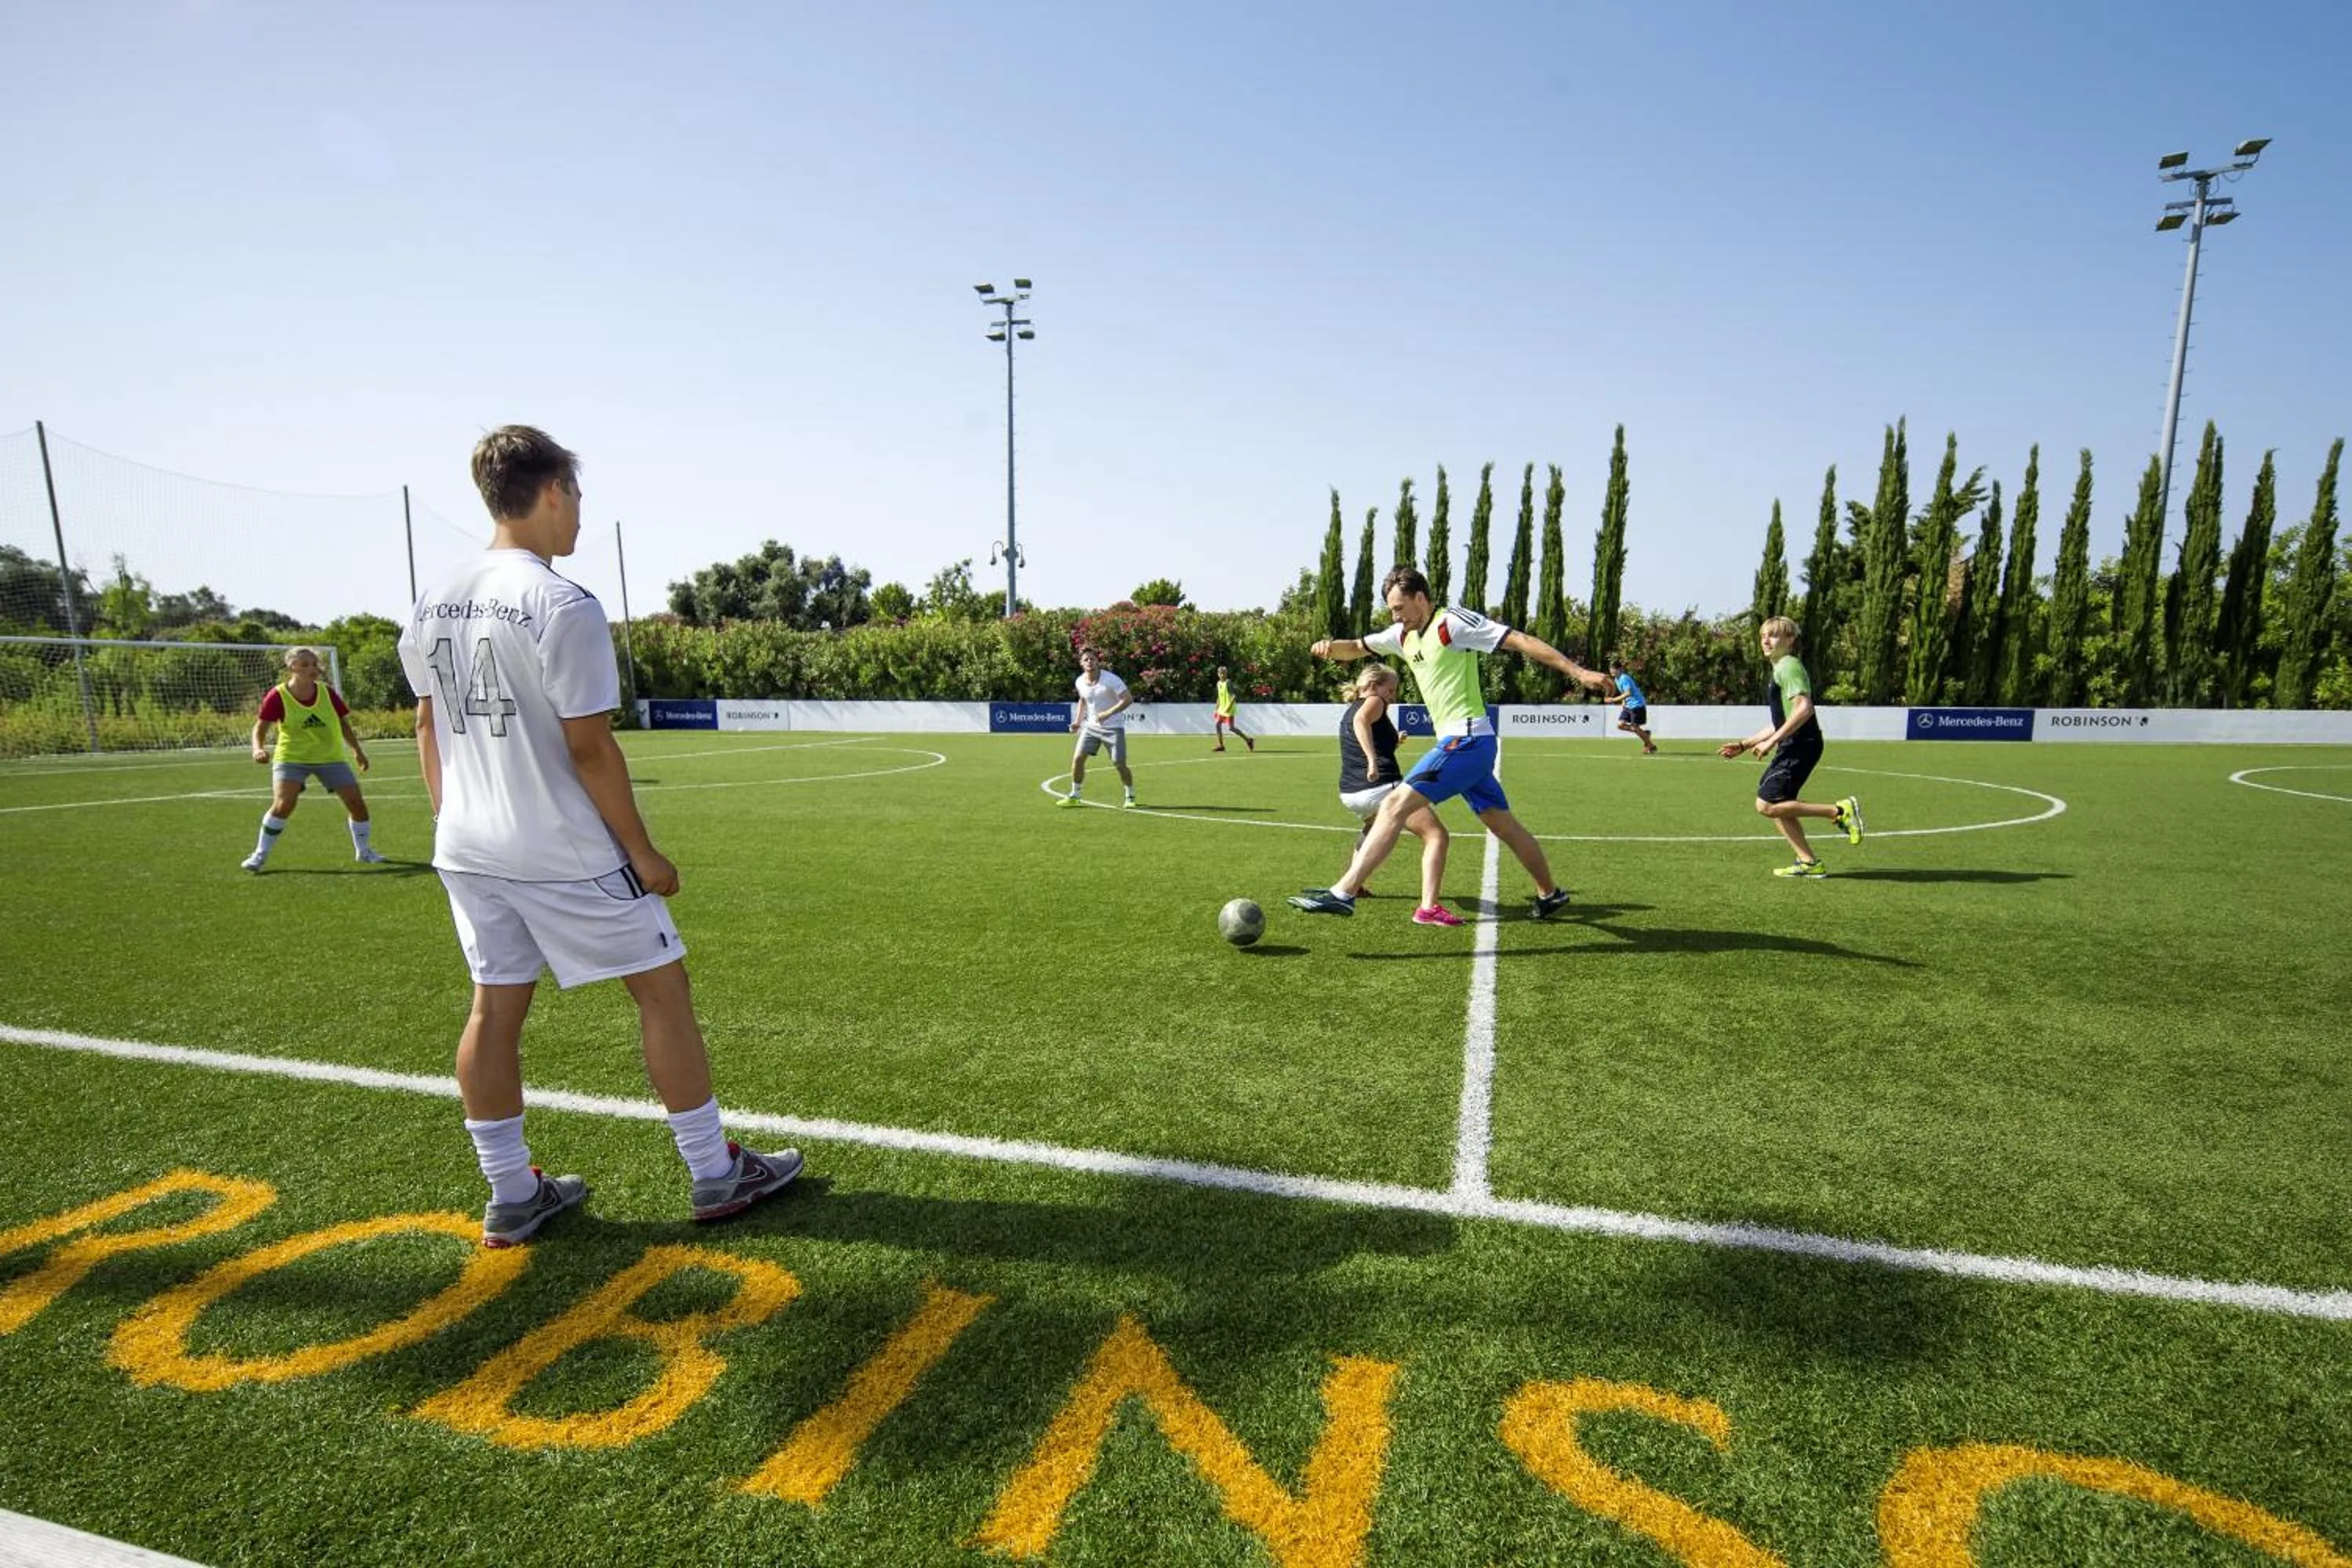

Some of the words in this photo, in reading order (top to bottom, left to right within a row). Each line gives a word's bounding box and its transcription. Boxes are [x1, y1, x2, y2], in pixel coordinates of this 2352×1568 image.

[419, 599, 533, 628] ercedes-Benz
[427, 637, 516, 737] 14
[1008, 713, 1065, 722] Mercedes-Benz
[1512, 714, 1577, 724] ROBINSON
[1937, 715, 2024, 727] Mercedes-Benz
[2050, 716, 2132, 727] ROBINSON
